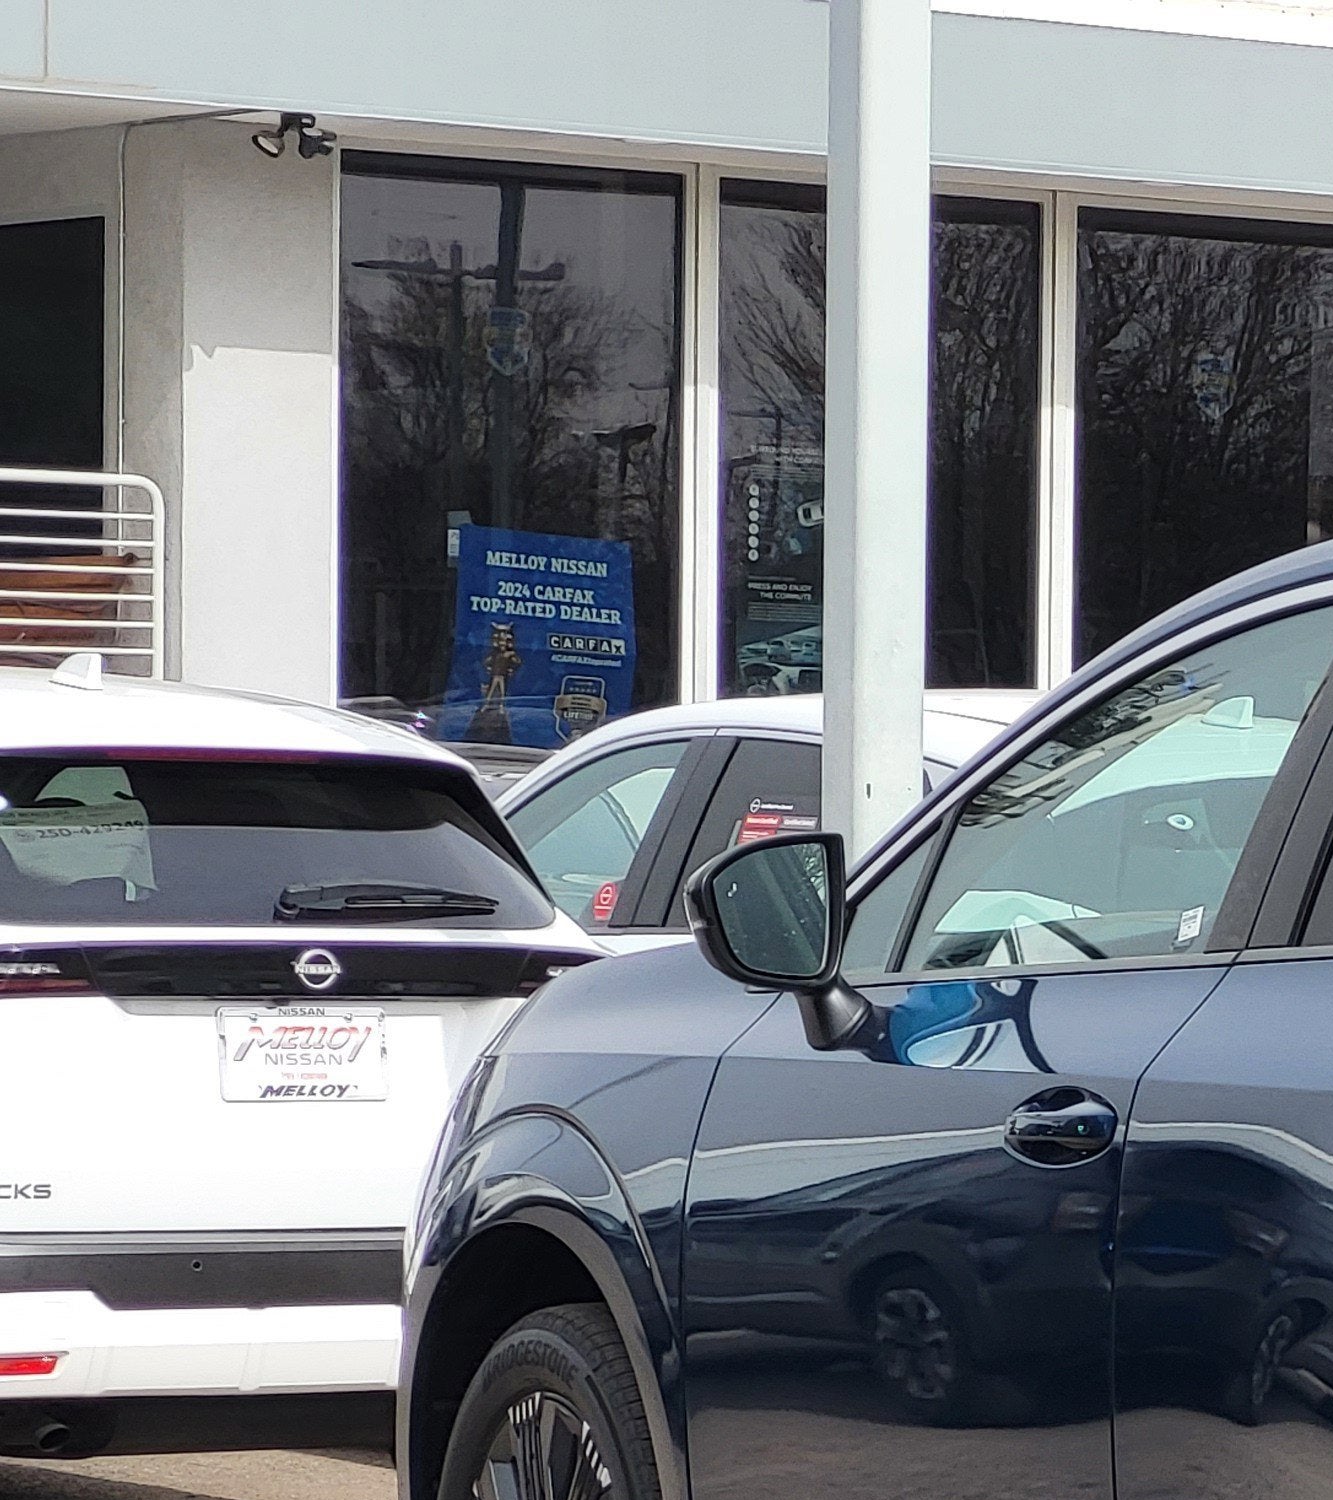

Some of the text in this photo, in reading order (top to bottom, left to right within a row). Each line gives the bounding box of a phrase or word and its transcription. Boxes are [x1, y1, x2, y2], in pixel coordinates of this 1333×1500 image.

[486, 550, 608, 578] MELLOY NISSAN
[497, 581, 595, 605] 2024 CARFAX
[470, 596, 622, 625] TOP-RATED DEALER
[550, 634, 625, 655] CARFAX
[278, 1007, 326, 1016] NISSAN
[233, 1026, 372, 1063] MELLOY
[264, 1053, 343, 1066] NISSAN
[260, 1084, 351, 1099] MELLOY
